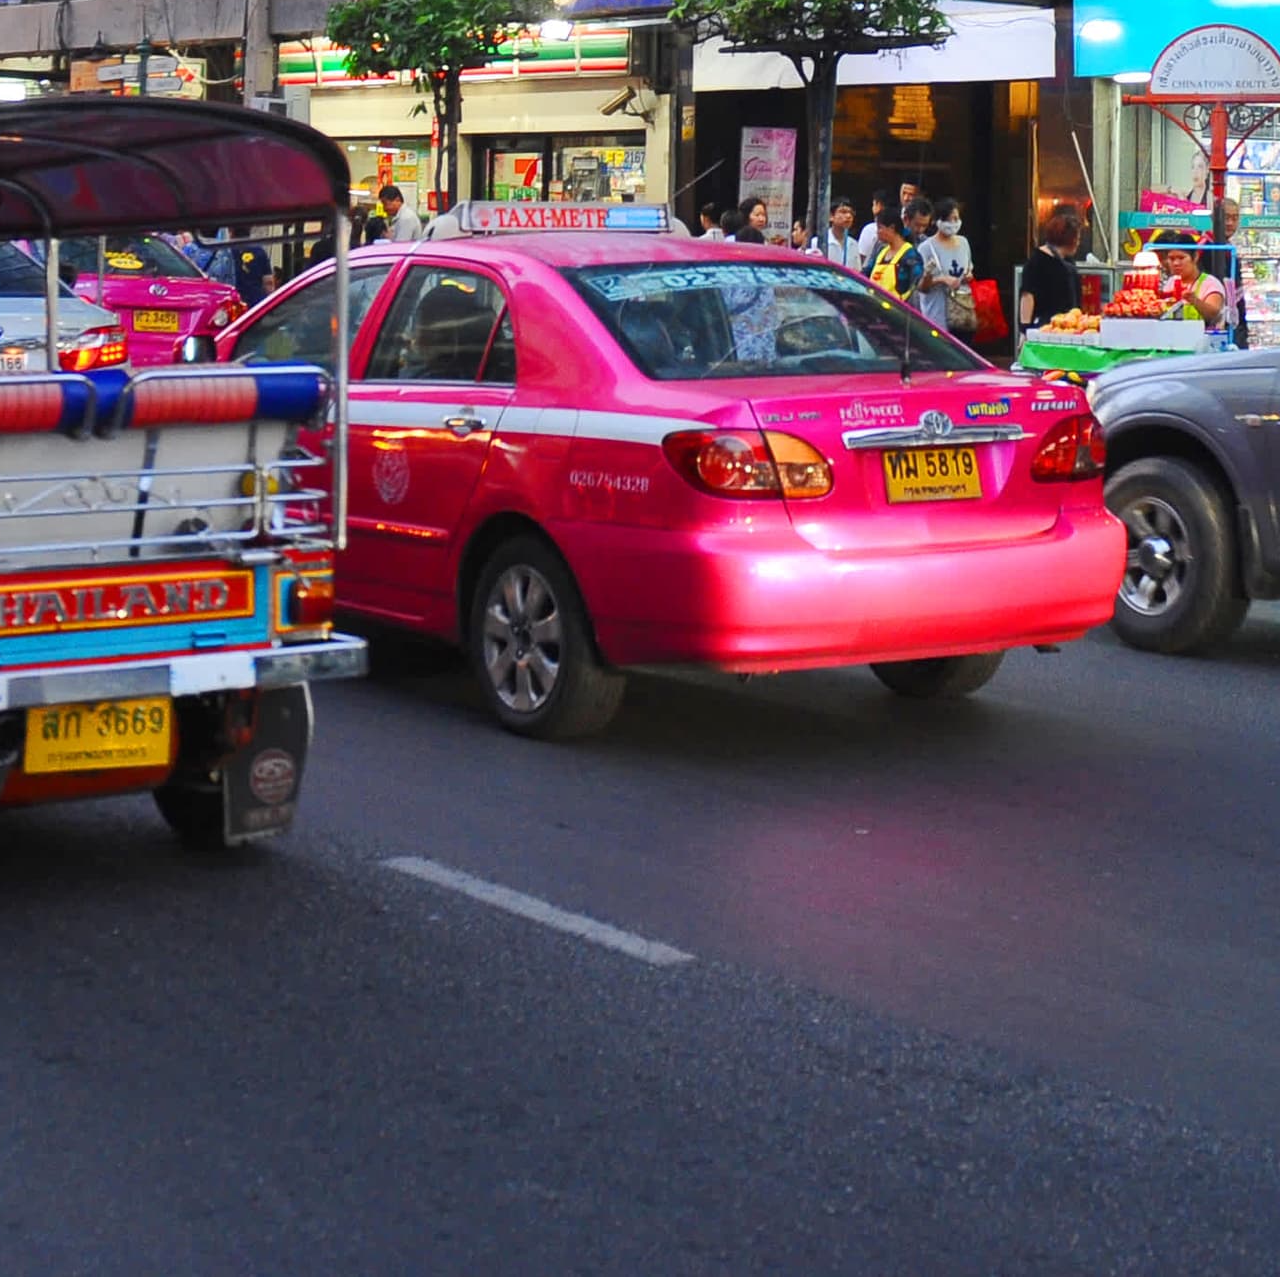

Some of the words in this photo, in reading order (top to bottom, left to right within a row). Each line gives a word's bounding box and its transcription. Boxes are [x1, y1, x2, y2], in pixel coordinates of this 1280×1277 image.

[1171, 78, 1233, 90] CHINATOWN
[926, 450, 974, 478] 5819
[96, 705, 165, 738] 3669
